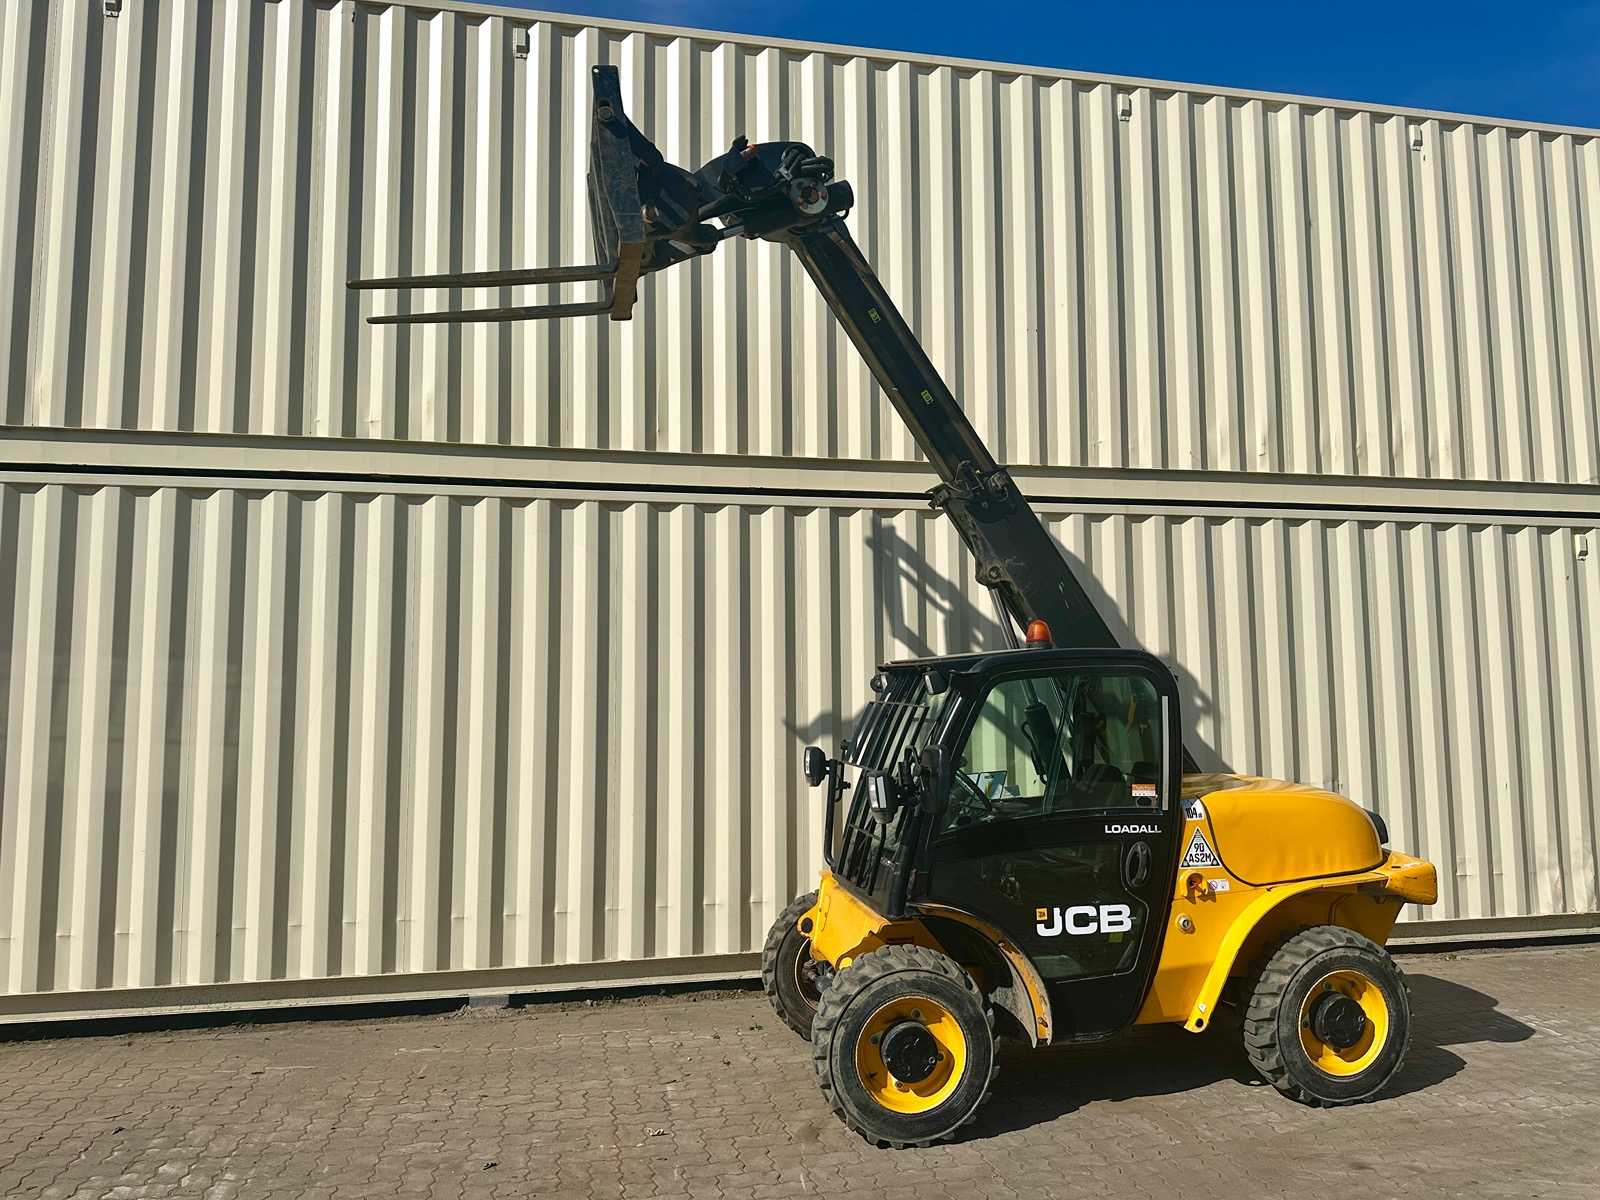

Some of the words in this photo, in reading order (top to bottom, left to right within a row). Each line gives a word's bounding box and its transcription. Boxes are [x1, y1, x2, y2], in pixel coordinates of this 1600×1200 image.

[1104, 824, 1162, 834] LOADALL
[1188, 853, 1212, 863] AS2M
[1036, 904, 1132, 937] JCB
